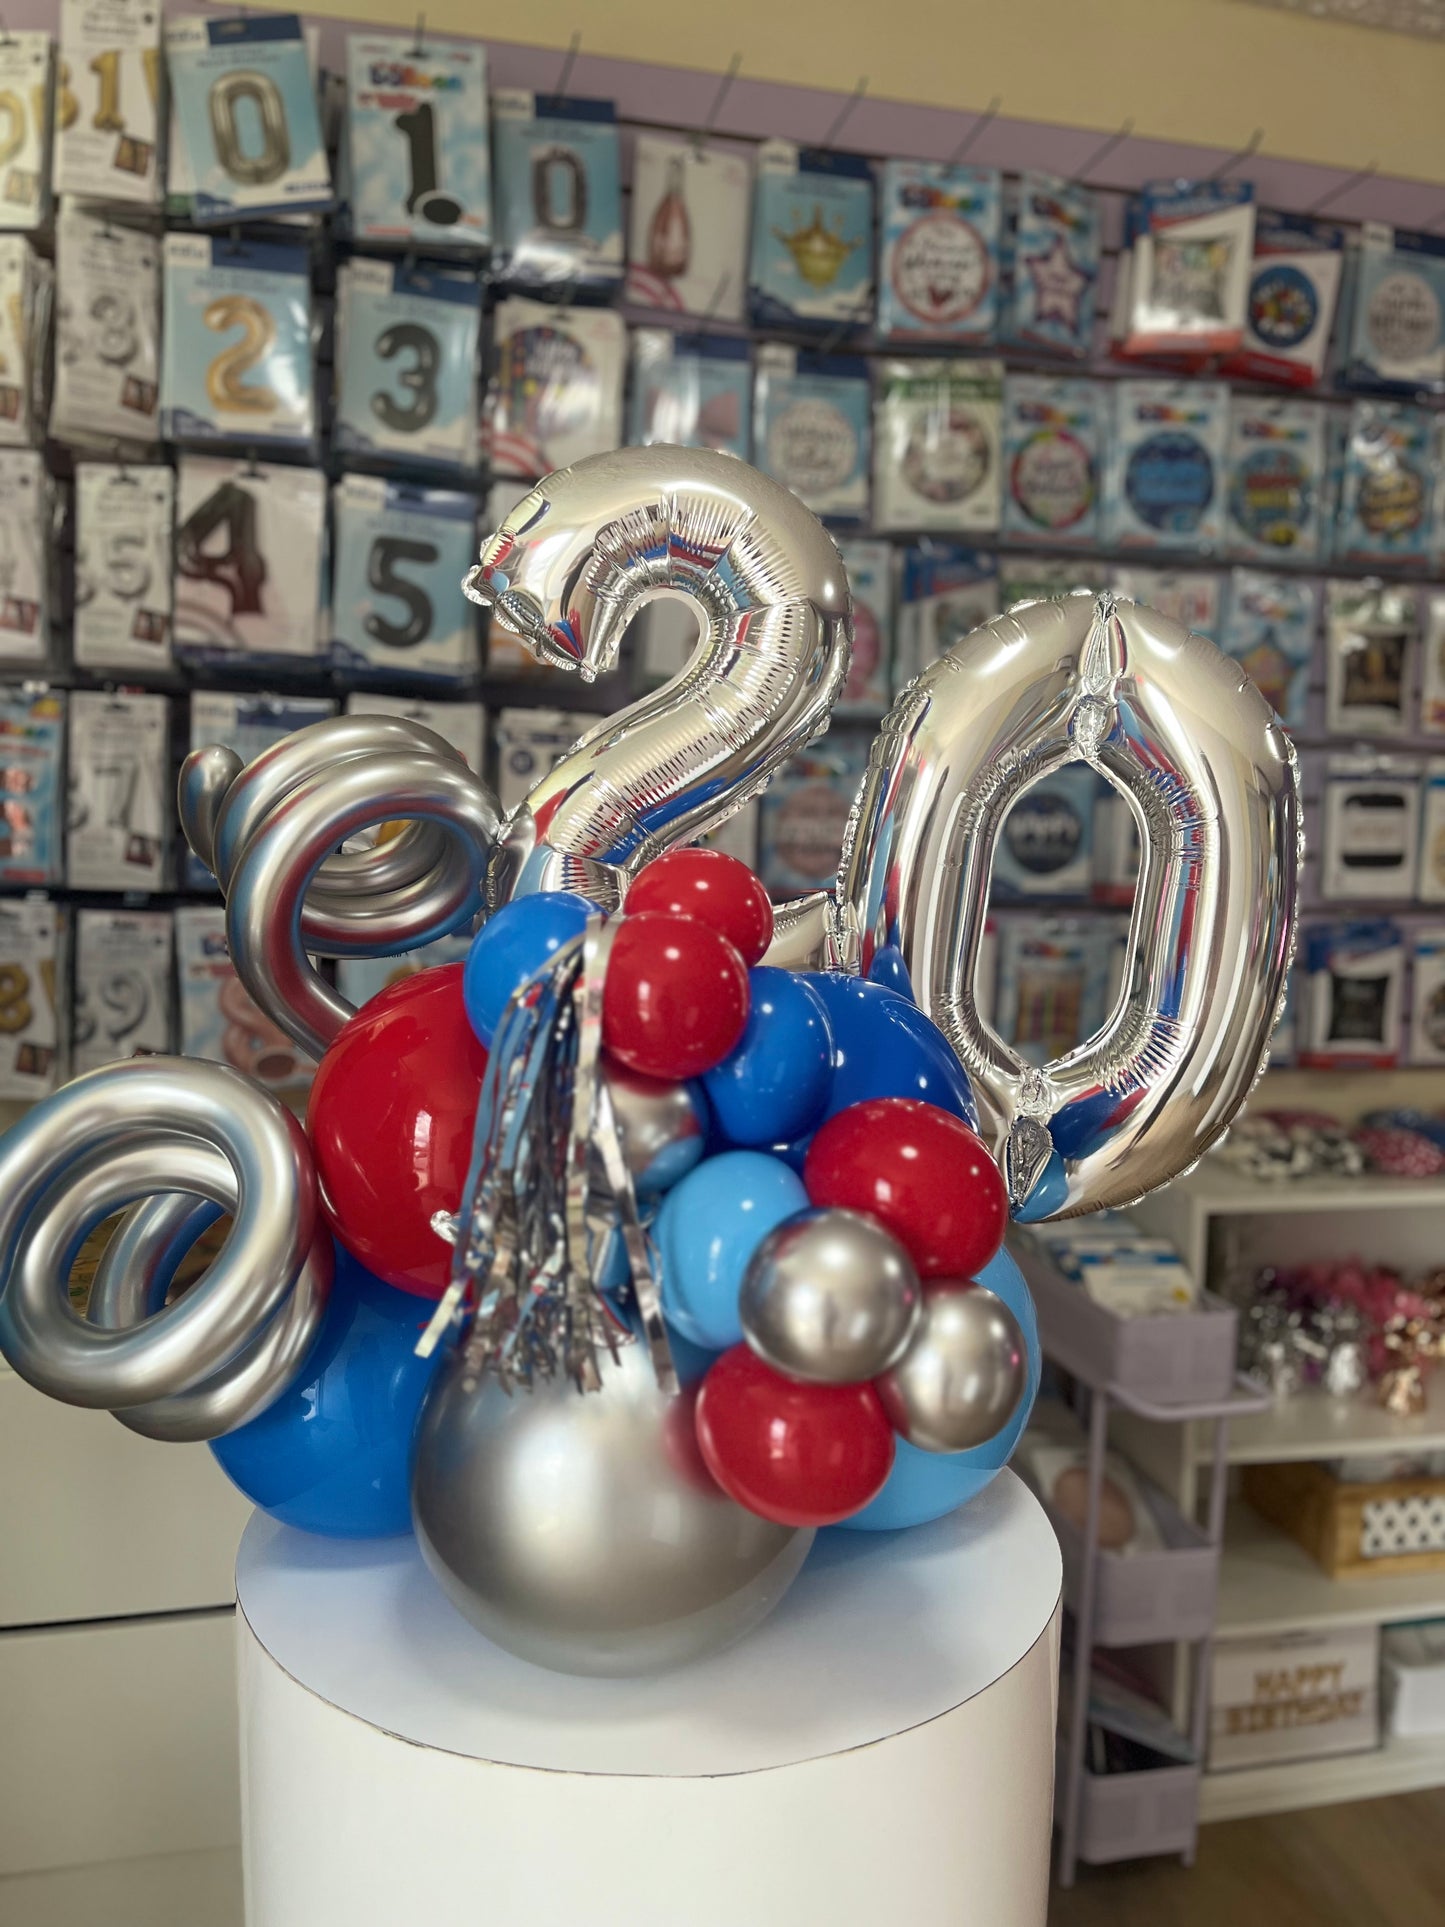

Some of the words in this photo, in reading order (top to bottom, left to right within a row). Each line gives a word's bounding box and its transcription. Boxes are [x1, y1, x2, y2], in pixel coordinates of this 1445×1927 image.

[208, 69, 291, 186] 0
[531, 141, 588, 231] 0
[204, 294, 278, 415] 2
[370, 322, 441, 434] 3
[178, 480, 267, 615] 4
[363, 535, 440, 648] 5
[1226, 1689, 1366, 1736] BIRTHDAY
[1254, 1660, 1346, 1698] HAPPY
